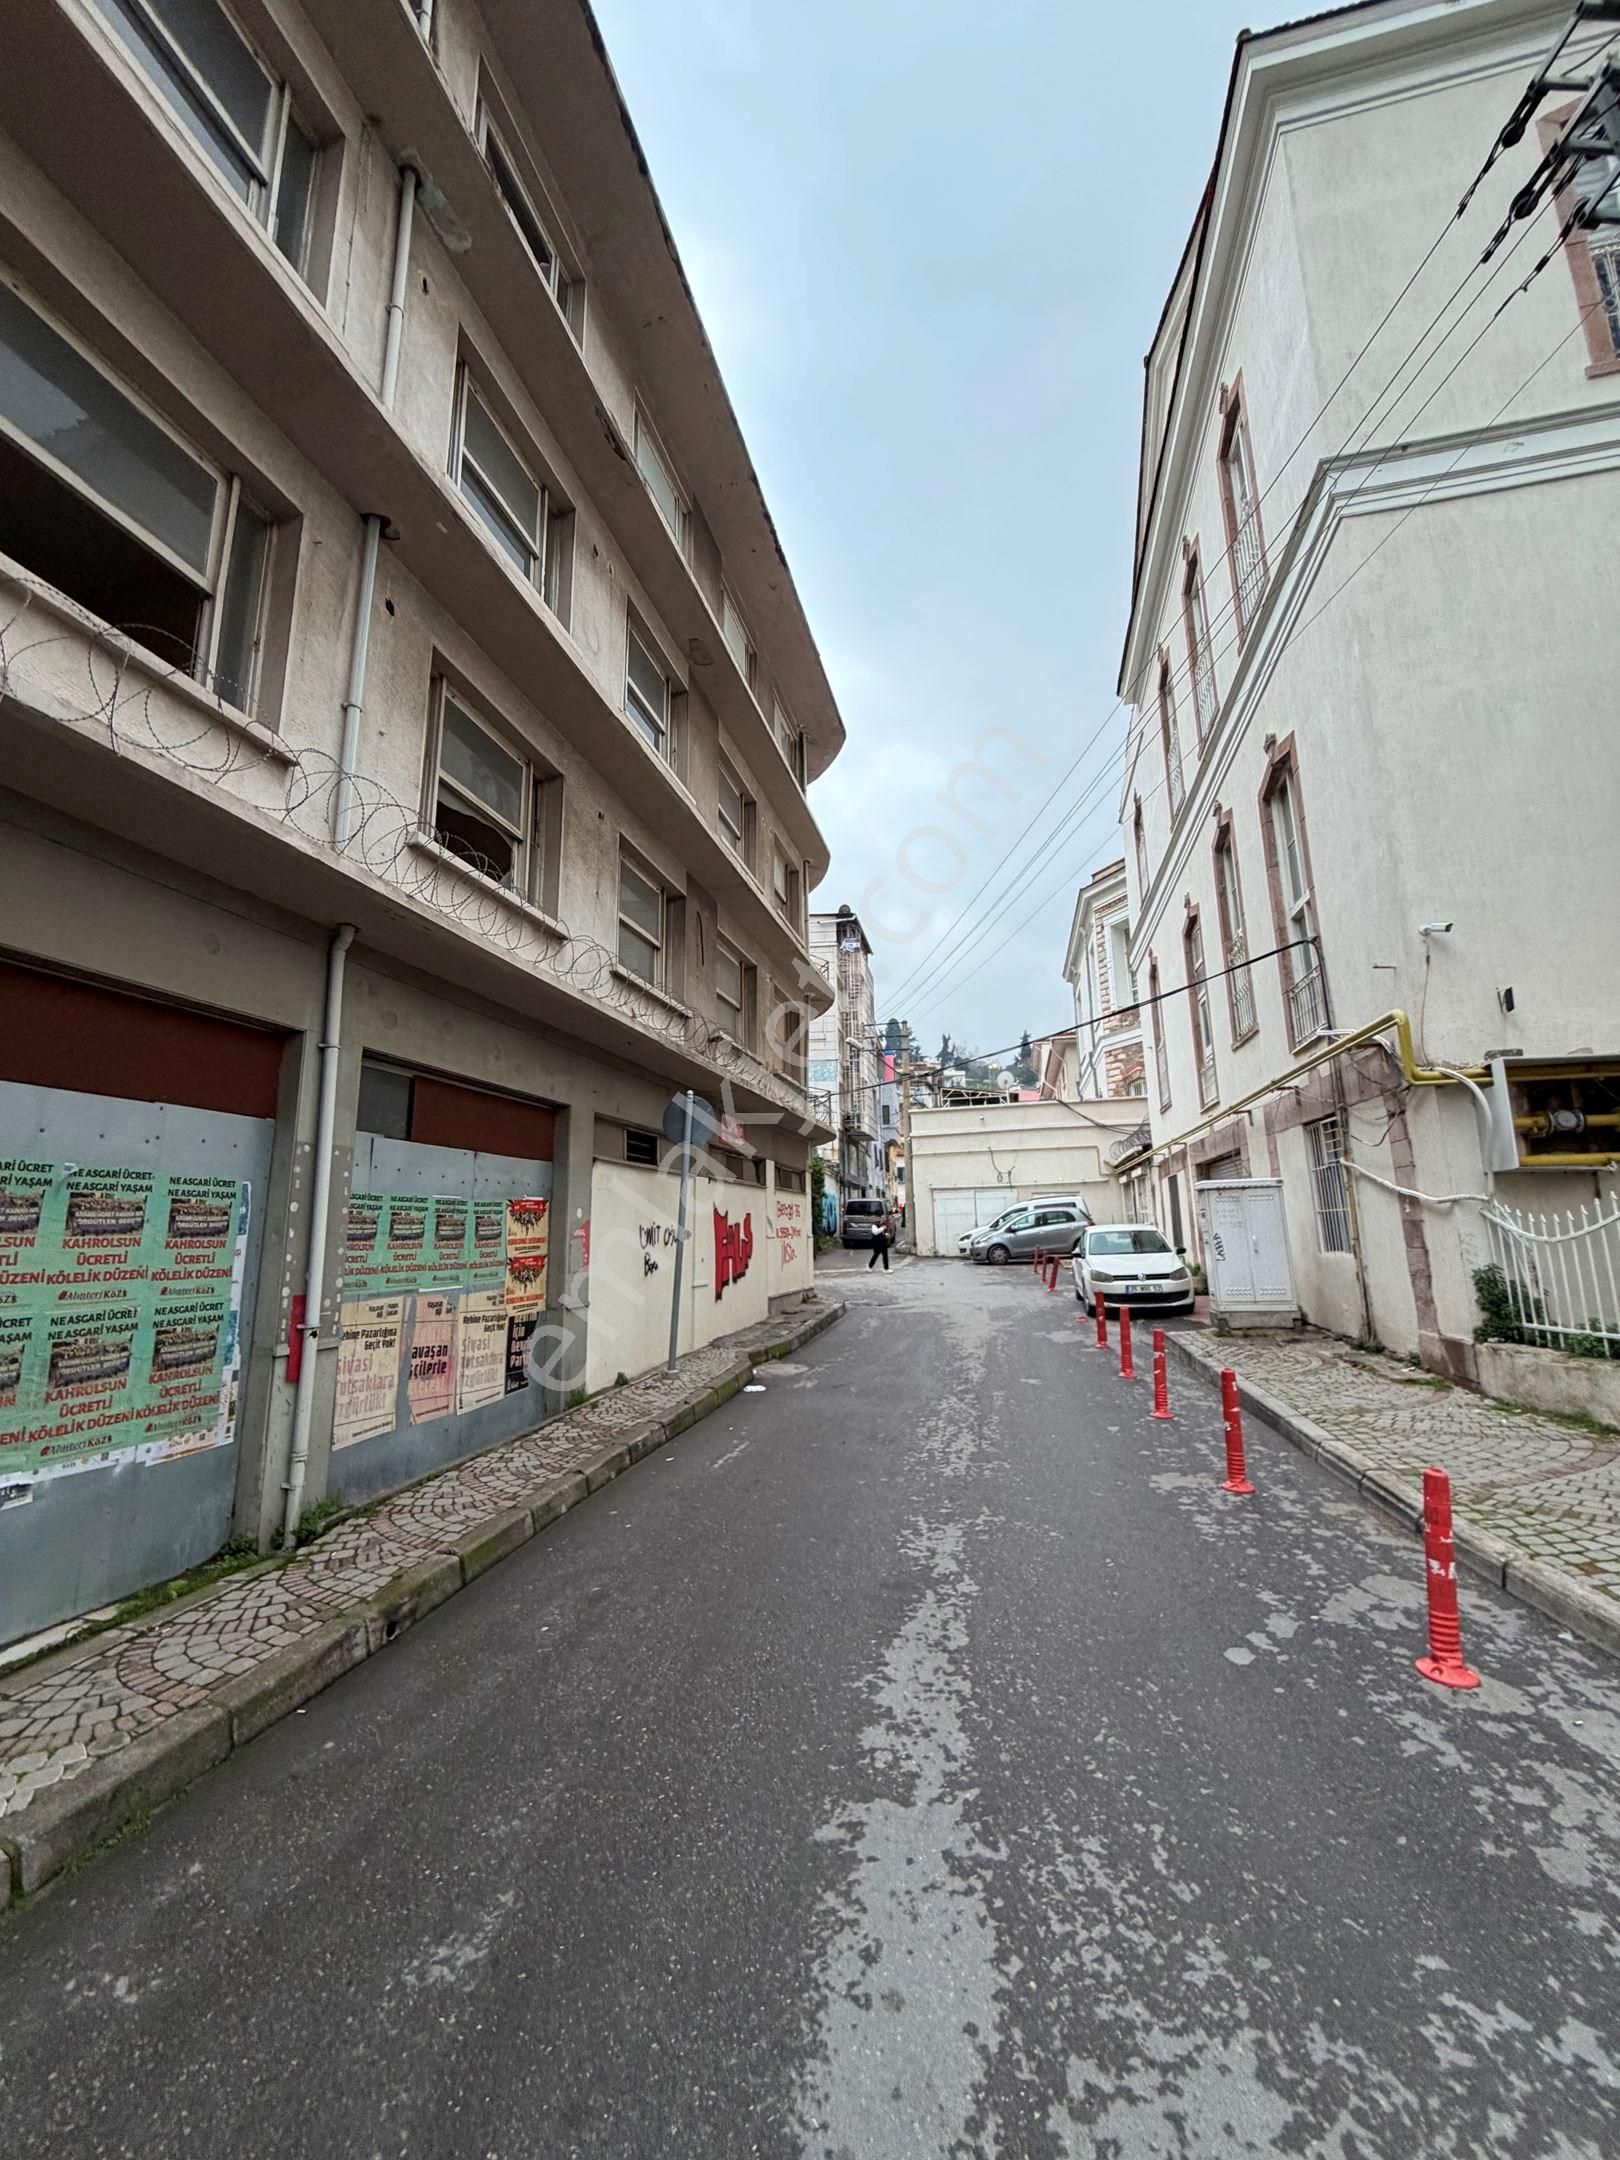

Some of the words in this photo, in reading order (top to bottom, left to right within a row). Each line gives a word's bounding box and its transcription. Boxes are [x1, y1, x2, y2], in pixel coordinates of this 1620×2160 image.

[18, 1160, 54, 1173] ÜCRET
[86, 1168, 122, 1179] ASGARİ
[123, 1169, 153, 1180] ÜCRET
[15, 1177, 53, 1189] YAŞAM
[66, 1182, 80, 1191] NE
[82, 1180, 119, 1191] ASGARİ
[121, 1184, 153, 1194] YAŞAM
[169, 1177, 182, 1186] NE
[182, 1177, 211, 1187] ASGARİ
[212, 1177, 236, 1188] ÜCRET
[168, 1189, 181, 1197] NE
[181, 1188, 210, 1198] ASGARİ
[211, 1191, 237, 1200] YAŞAM
[62, 1237, 141, 1249] KAHROLSUN
[164, 1239, 227, 1250] KAHROLSUN
[76, 1251, 129, 1266] ÜCRETLİ
[175, 1251, 216, 1265] ÜCRETLİ
[46, 1269, 101, 1285] KÖLELİK
[103, 1265, 149, 1281] DÜZENİ
[151, 1268, 195, 1281] KÖLELİK
[195, 1265, 233, 1279] DÜZENİ
[154, 1307, 166, 1316] NE
[166, 1303, 199, 1315] ASGARİ
[199, 1302, 224, 1312] ÜCRET
[50, 1318, 66, 1327] NE
[66, 1312, 106, 1325] ASGARİ
[152, 1320, 166, 1329] NE
[166, 1316, 197, 1328] ASGARİ
[197, 1314, 224, 1325] YAŞAM
[48, 1331, 64, 1341] NE
[65, 1326, 104, 1340] ASGARİ
[105, 1322, 139, 1334] YAŞAM
[342, 1329, 359, 1341] ehine
[412, 1345, 448, 1360] avaşan
[148, 1364, 214, 1385] KAHROLSUN
[43, 1378, 127, 1404] KAHROLSUN
[159, 1379, 202, 1399] ÜCRETLİ
[59, 1395, 113, 1419] ÜCRETLİ
[339, 1393, 386, 1418] zgürlük!
[28, 1419, 86, 1443] KÖLELİK
[87, 1407, 135, 1430] DÜZENİ
